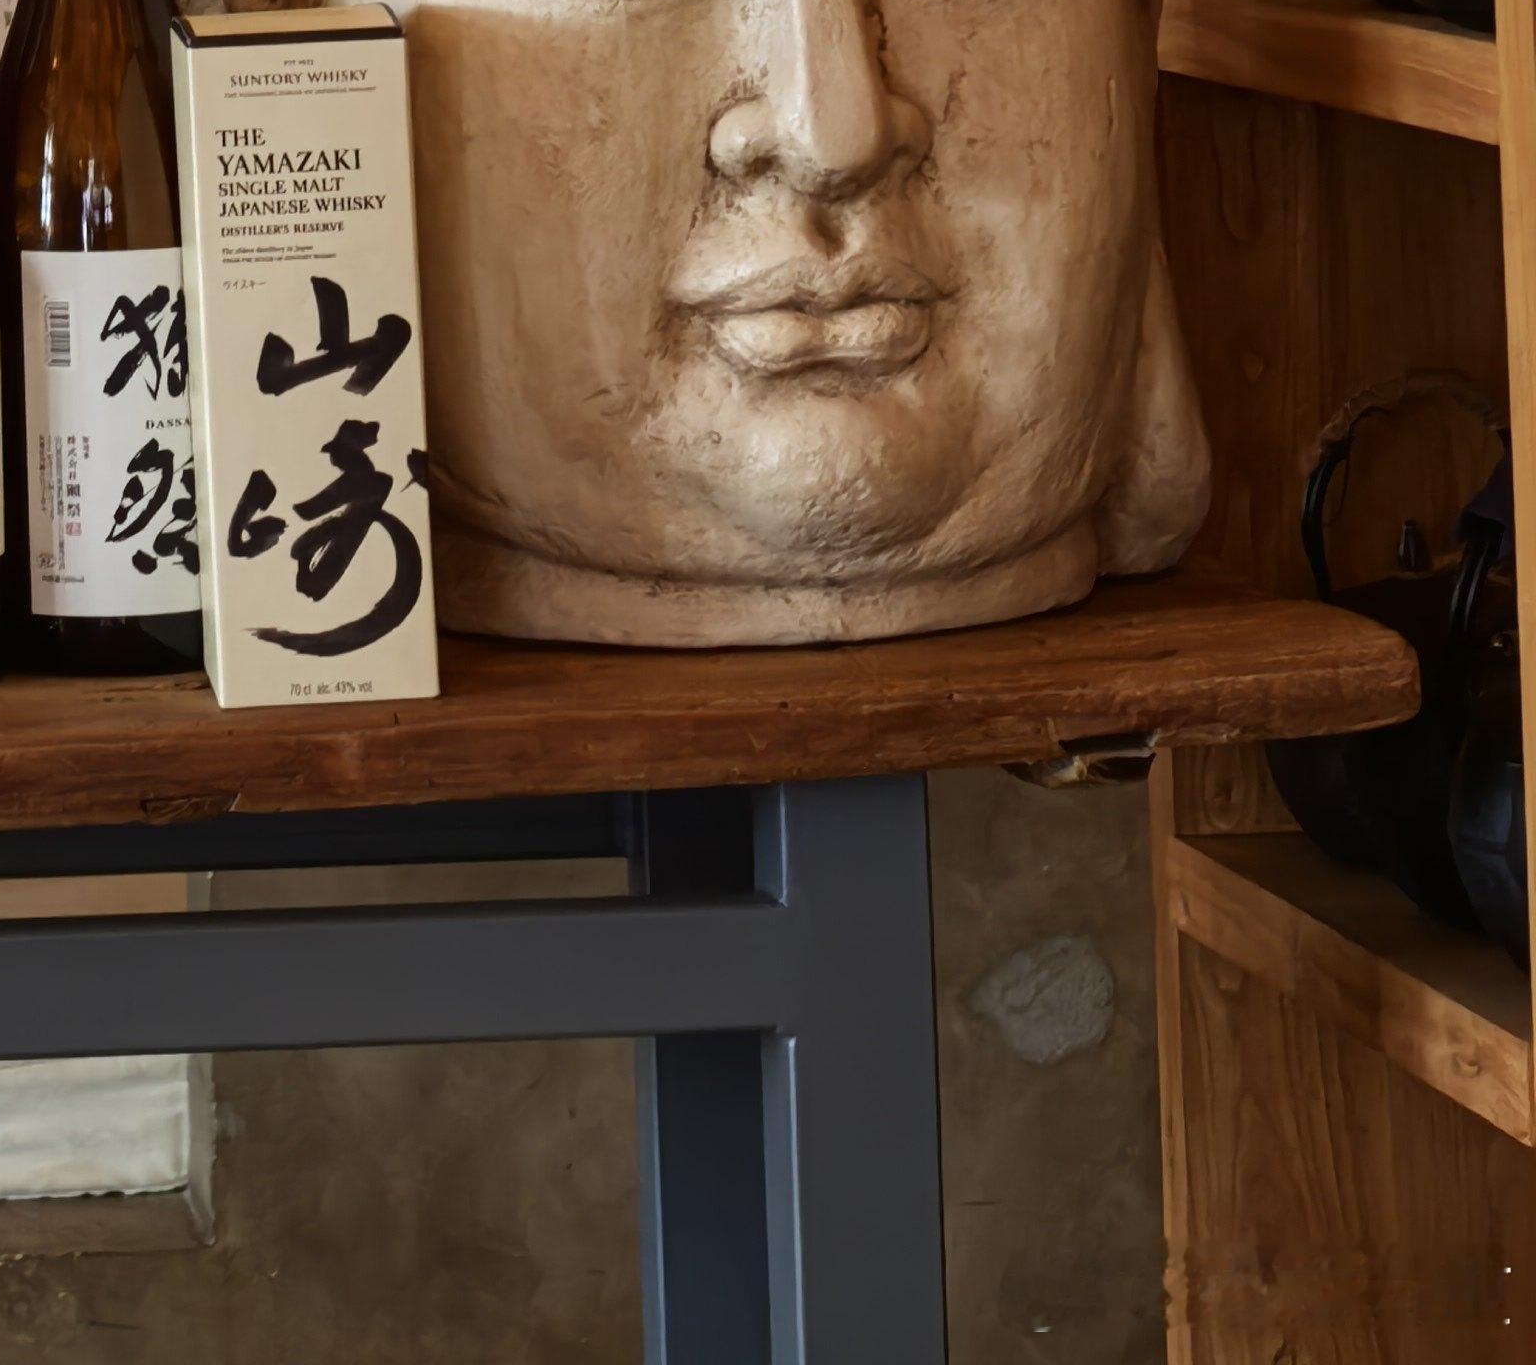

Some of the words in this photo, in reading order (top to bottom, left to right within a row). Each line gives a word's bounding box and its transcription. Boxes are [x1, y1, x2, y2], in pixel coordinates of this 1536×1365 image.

[230, 72, 303, 88] SUNTORY
[307, 69, 369, 84] WHISKY
[215, 128, 266, 147] THE
[217, 148, 362, 177] YAMAZAKI
[218, 180, 287, 197] SINGLE
[292, 177, 345, 194] MALT
[219, 200, 311, 218] JAPANESE
[315, 195, 387, 213] WHISKY
[220, 224, 290, 238] DISTILLER'S
[294, 221, 345, 234] RESERVE
